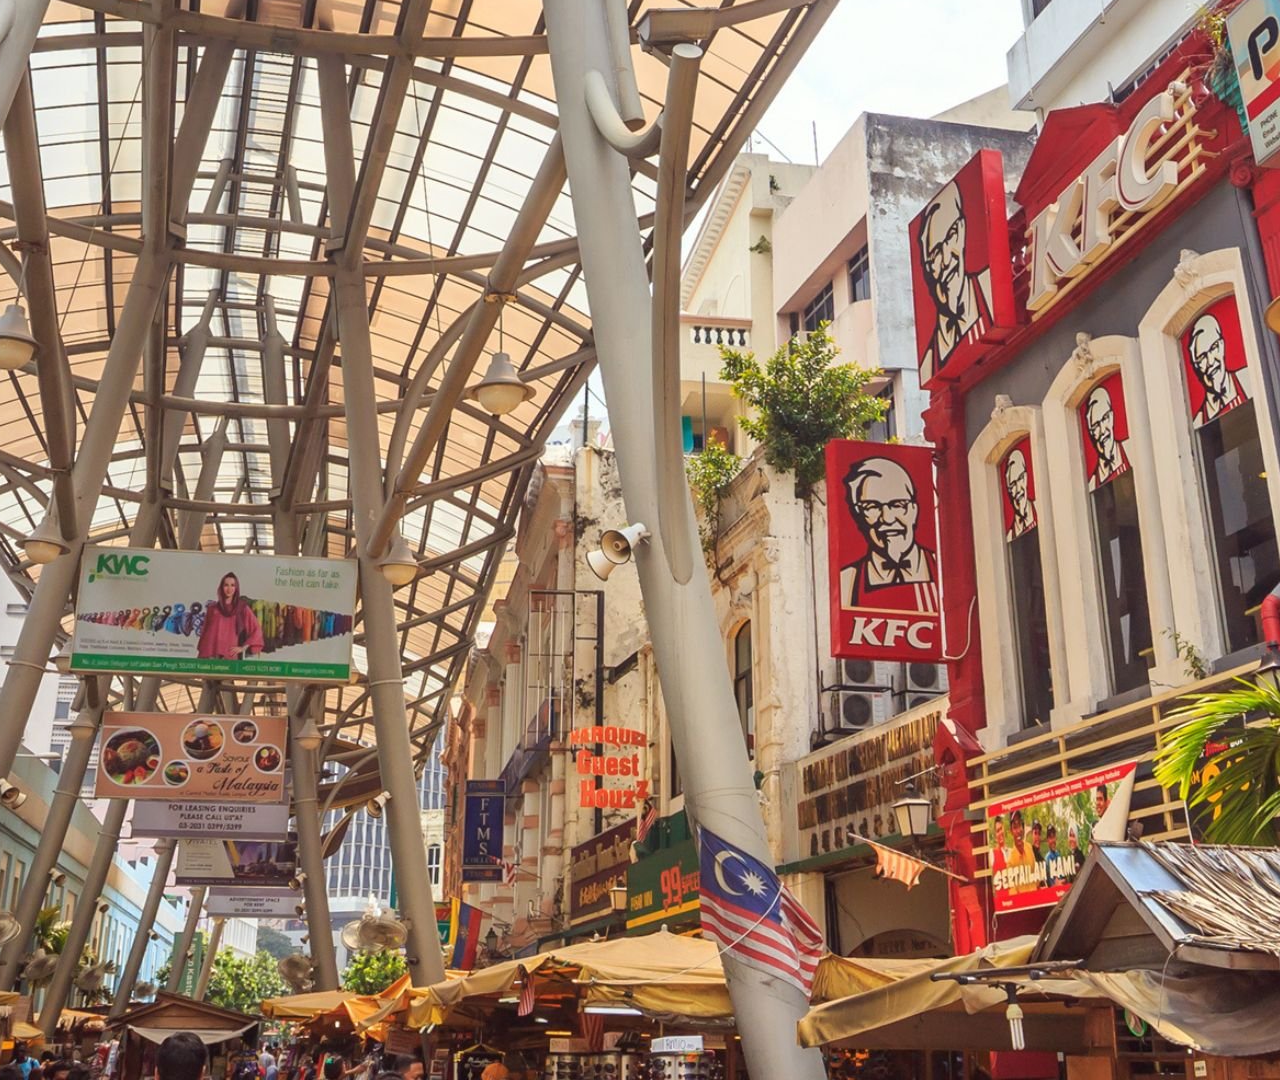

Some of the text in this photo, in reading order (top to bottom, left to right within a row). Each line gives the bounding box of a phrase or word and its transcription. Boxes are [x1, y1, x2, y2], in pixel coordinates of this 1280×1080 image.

[1027, 91, 1178, 310] KFC
[96, 554, 151, 576] KWC
[276, 566, 340, 578] Fashion as far as
[274, 577, 288, 586] the
[289, 578, 304, 588] feet
[305, 580, 320, 588] can
[847, 616, 934, 650] KFC
[222, 752, 250, 763] Savour
[577, 749, 639, 777] Guest
[207, 762, 233, 774] Taste
[235, 763, 249, 777] of
[212, 776, 280, 797] Malaysia
[476, 797, 490, 856] FTMS
[993, 855, 1077, 891] SERTAILAH KAMI
